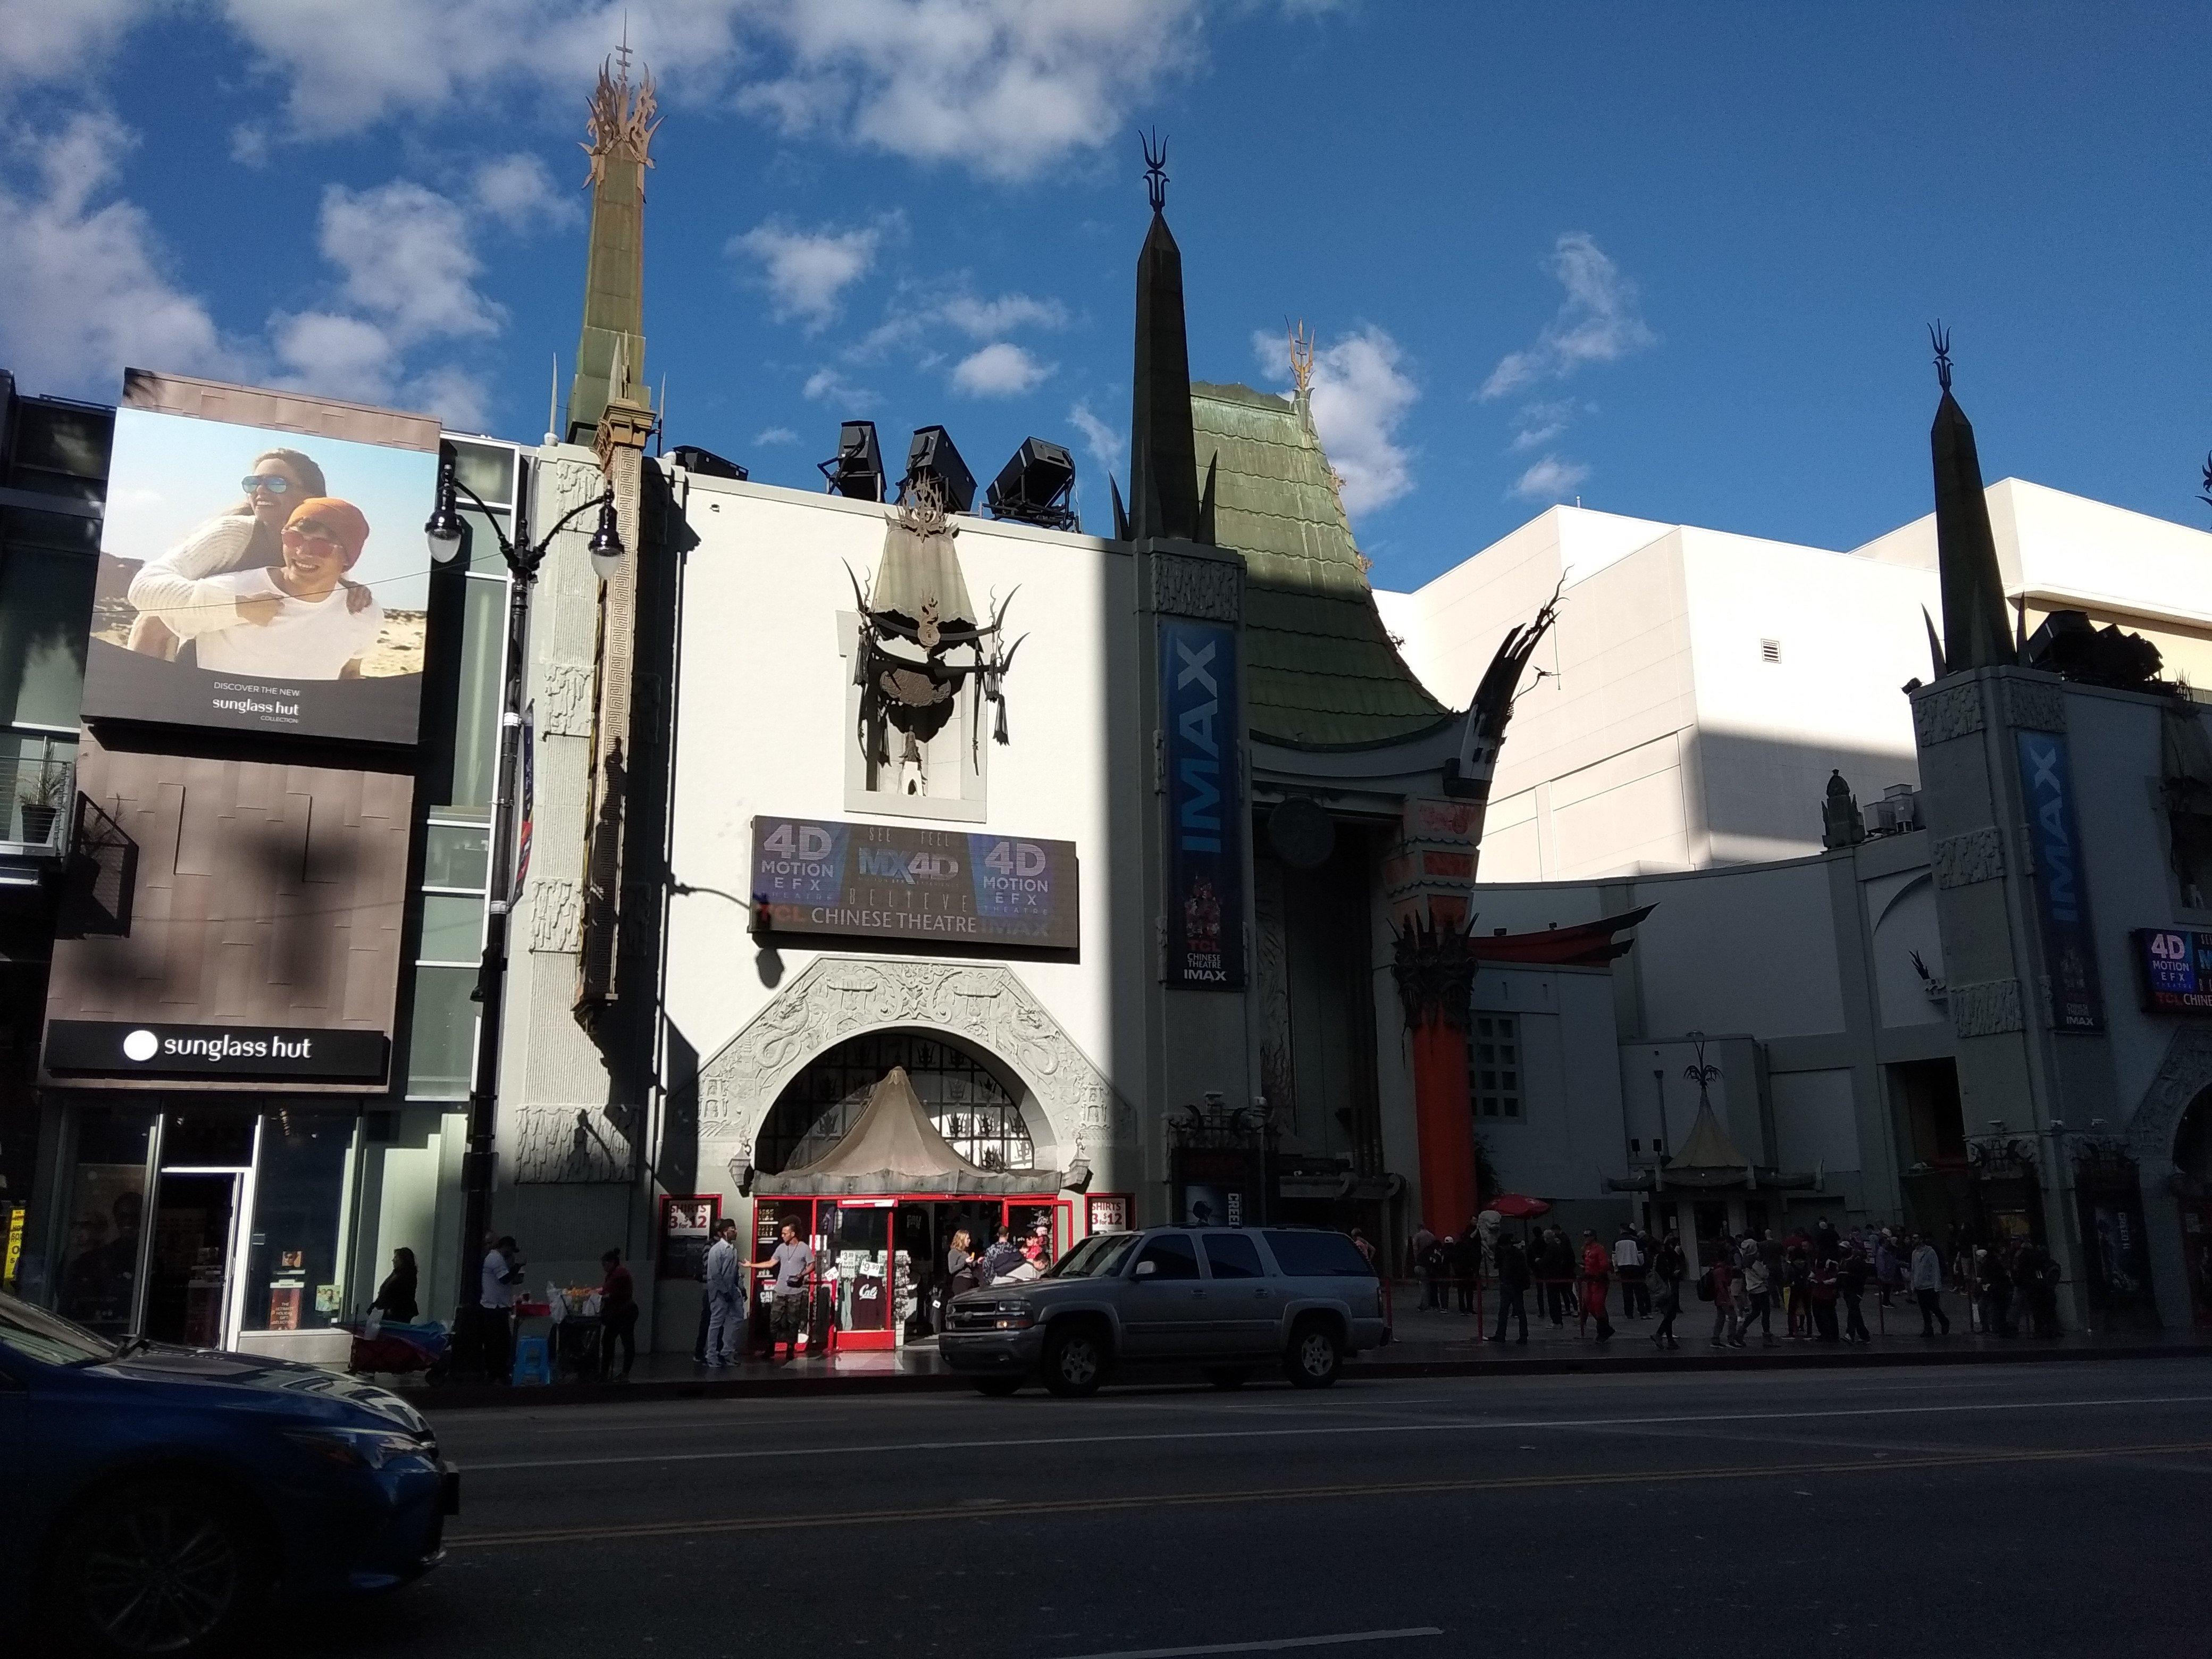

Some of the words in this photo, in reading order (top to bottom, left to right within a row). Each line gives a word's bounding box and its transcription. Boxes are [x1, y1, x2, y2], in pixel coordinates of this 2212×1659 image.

[214, 682, 259, 692] DISCOVER
[261, 686, 278, 695] THE
[279, 688, 300, 697] NEW
[213, 698, 273, 714] sunglass
[275, 701, 299, 716] hut
[261, 715, 298, 724] COLLECTION
[1176, 638, 1221, 853] IMAX
[763, 824, 833, 861] 4D
[869, 827, 891, 843] SEE
[921, 831, 949, 847] FEEL
[2030, 746, 2079, 924] IMAX
[985, 841, 1046, 877] 4D
[761, 860, 834, 877] MOTION
[984, 876, 1049, 893] MOTION
[811, 907, 892, 928] CHINESE
[895, 912, 977, 933] THEATRE
[2151, 933, 2185, 960] 4D
[1187, 952, 1221, 961] CHINESE
[1187, 960, 1221, 969] THEATRE
[2152, 960, 2190, 971] MOTION
[1184, 969, 1227, 982] IMAX
[2066, 1016, 2094, 1026] IMAX
[164, 1034, 267, 1061] sunglass
[272, 1036, 312, 1058] hut
[1092, 1202, 1121, 1211] SHIRTS
[670, 1216, 678, 1228] 3
[1092, 1213, 1099, 1225] 3
